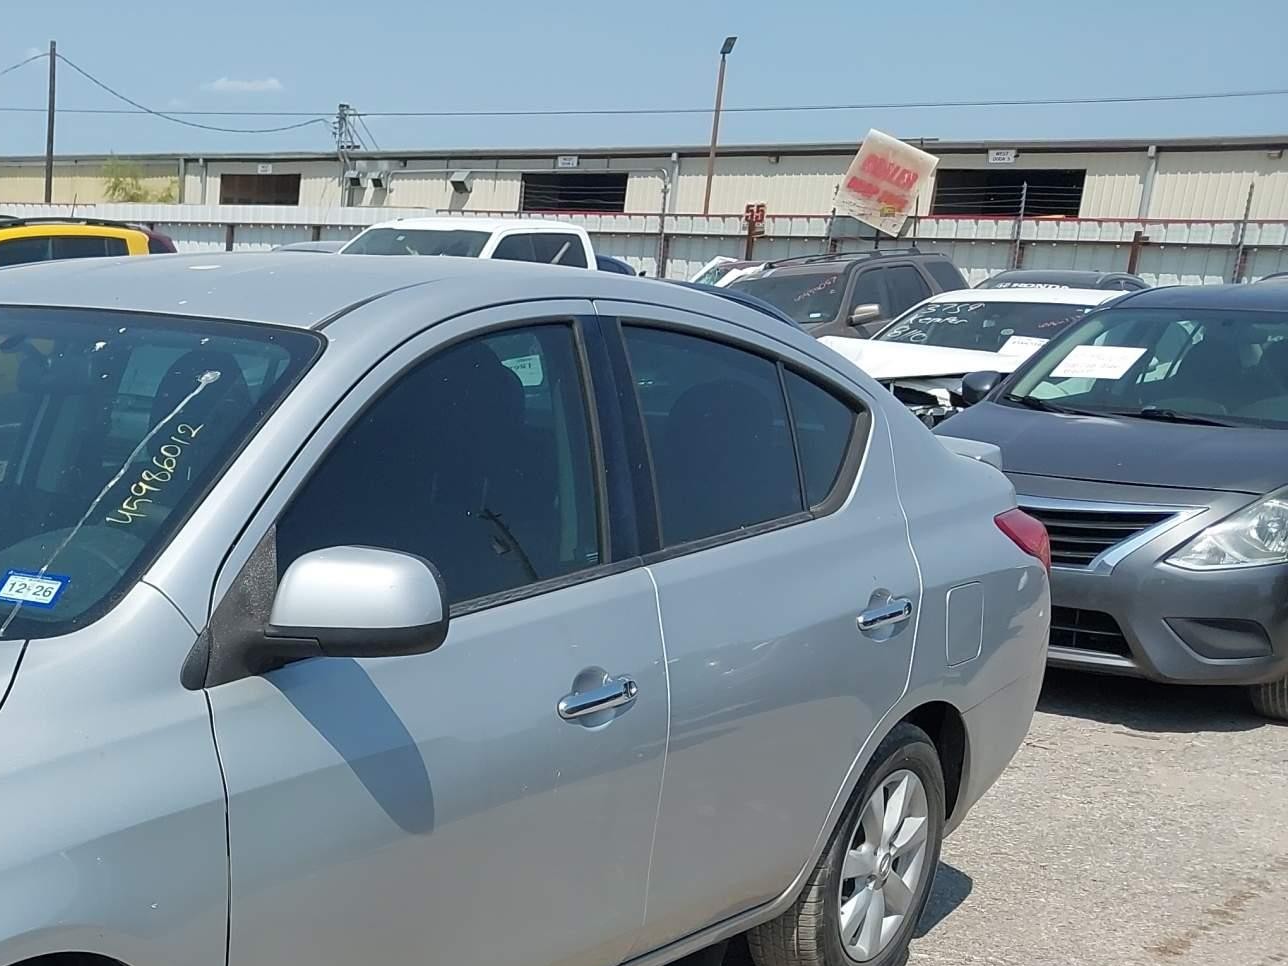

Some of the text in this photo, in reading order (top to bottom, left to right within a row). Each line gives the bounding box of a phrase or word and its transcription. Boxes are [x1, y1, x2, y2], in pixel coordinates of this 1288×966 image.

[745, 204, 765, 223] 55
[106, 423, 205, 524] 45986012
[8, 581, 54, 598] 12 26
